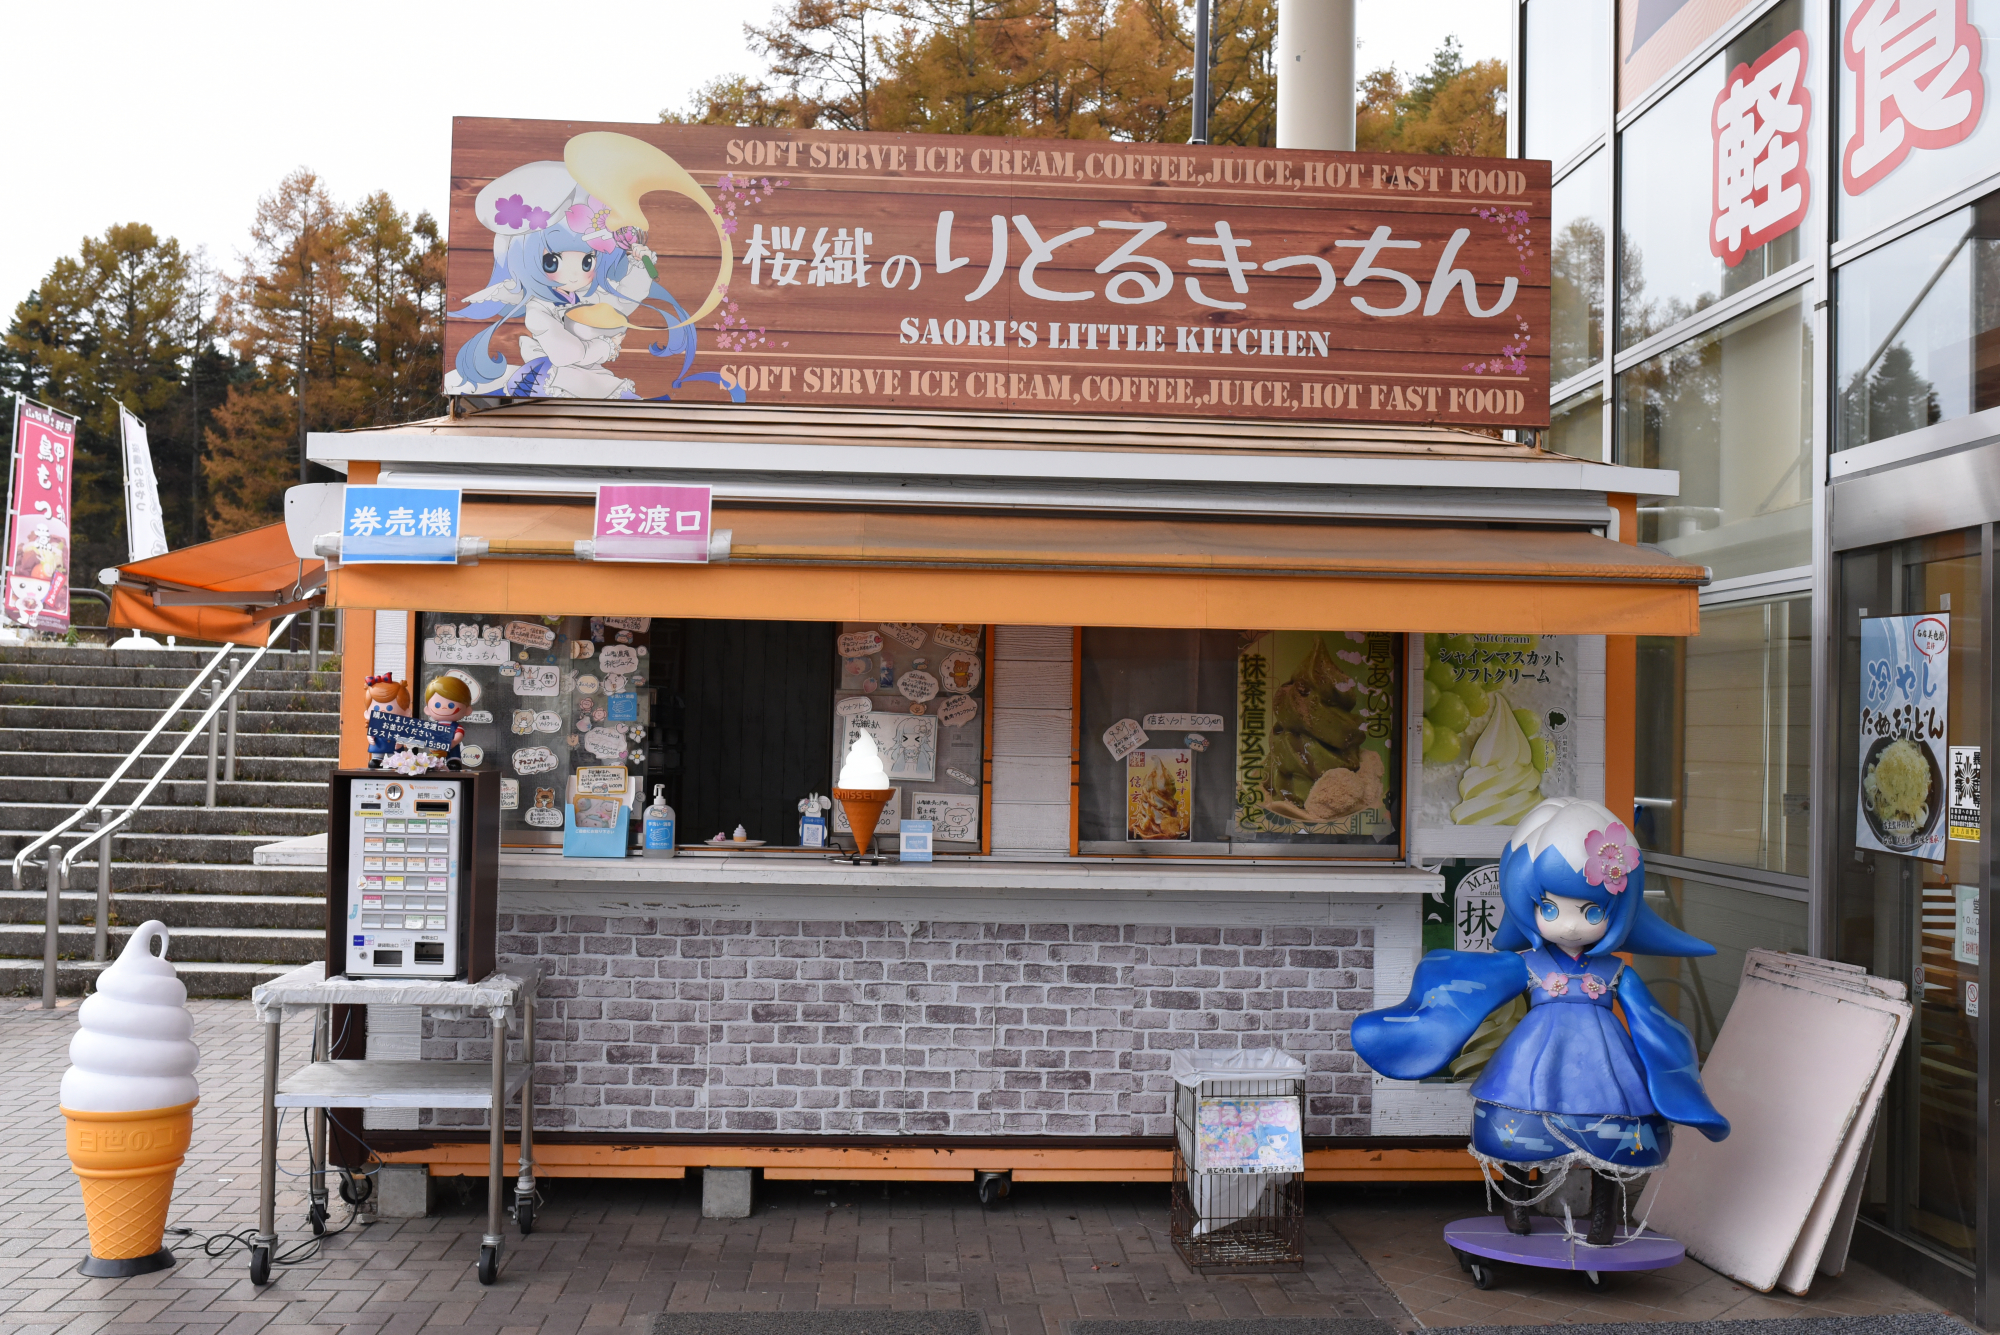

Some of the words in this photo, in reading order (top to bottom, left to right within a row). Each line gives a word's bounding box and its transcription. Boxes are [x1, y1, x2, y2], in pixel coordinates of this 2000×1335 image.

[726, 139, 803, 168] SOFT
[809, 142, 907, 172] SERVE
[914, 146, 964, 173] ICE
[1371, 163, 1444, 192] FAST
[1450, 167, 1527, 196] FOOD
[743, 210, 1519, 318] 桜織のりとるきっちん
[900, 317, 1037, 348] SAORI'S
[1048, 321, 1166, 353] LITTLE
[1176, 325, 1331, 358] KITCHEN
[719, 364, 797, 392] SOFT
[803, 366, 901, 395] SERVE
[908, 369, 959, 397] ICE
[1370, 382, 1443, 412] FAST
[1448, 385, 1525, 414] FOOD
[349, 506, 452, 537] 券売機
[604, 504, 701, 535] 受渡口
[436, 651, 501, 661] りとるきっちん
[1438, 648, 1565, 668] シャインマスカット
[1453, 667, 1551, 685] ソフトクリーム
[1867, 658, 1938, 702] 冷やし
[373, 711, 451, 733] 購入しましたら受渡口に
[382, 722, 435, 740] お並びください。
[1147, 715, 1186, 726] 信玄ソフト
[1190, 715, 1222, 727] 500yen
[1861, 704, 1944, 740] たぬきうどん
[1954, 750, 1963, 807] 立入禁止
[841, 791, 875, 800] NISSEI
[1457, 898, 1499, 939] 抹
[1201, 1104, 1298, 1123] 萌えるごみ
